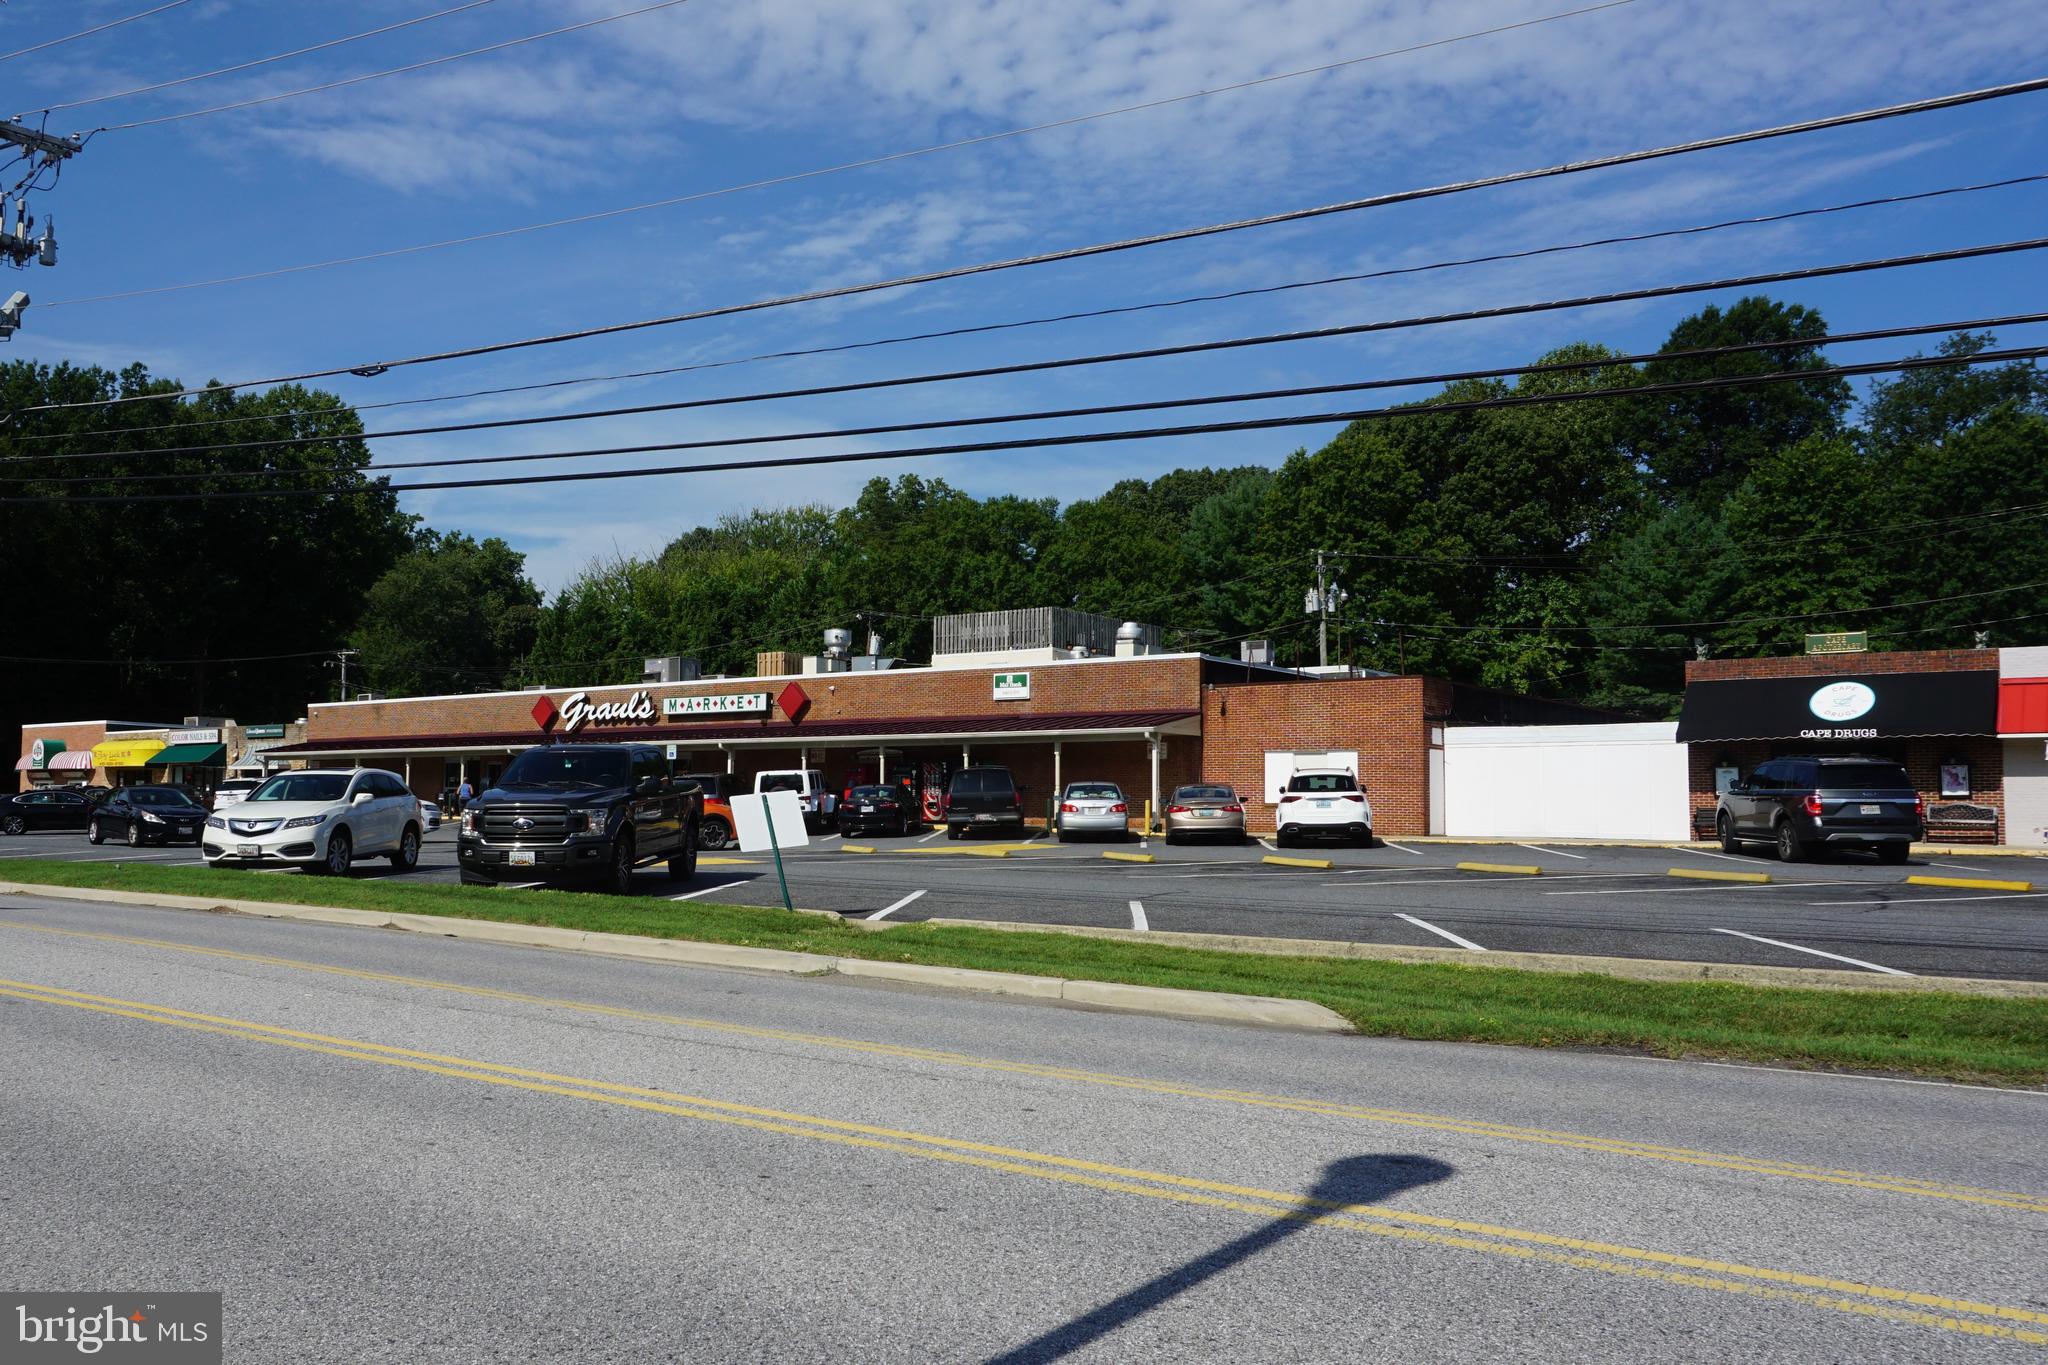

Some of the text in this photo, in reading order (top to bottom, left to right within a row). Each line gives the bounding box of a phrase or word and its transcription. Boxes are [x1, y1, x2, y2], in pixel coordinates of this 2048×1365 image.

[560, 690, 655, 732] Graul's
[172, 733, 188, 741] COLOR
[1800, 728, 1877, 739] CAPE DRUGS
